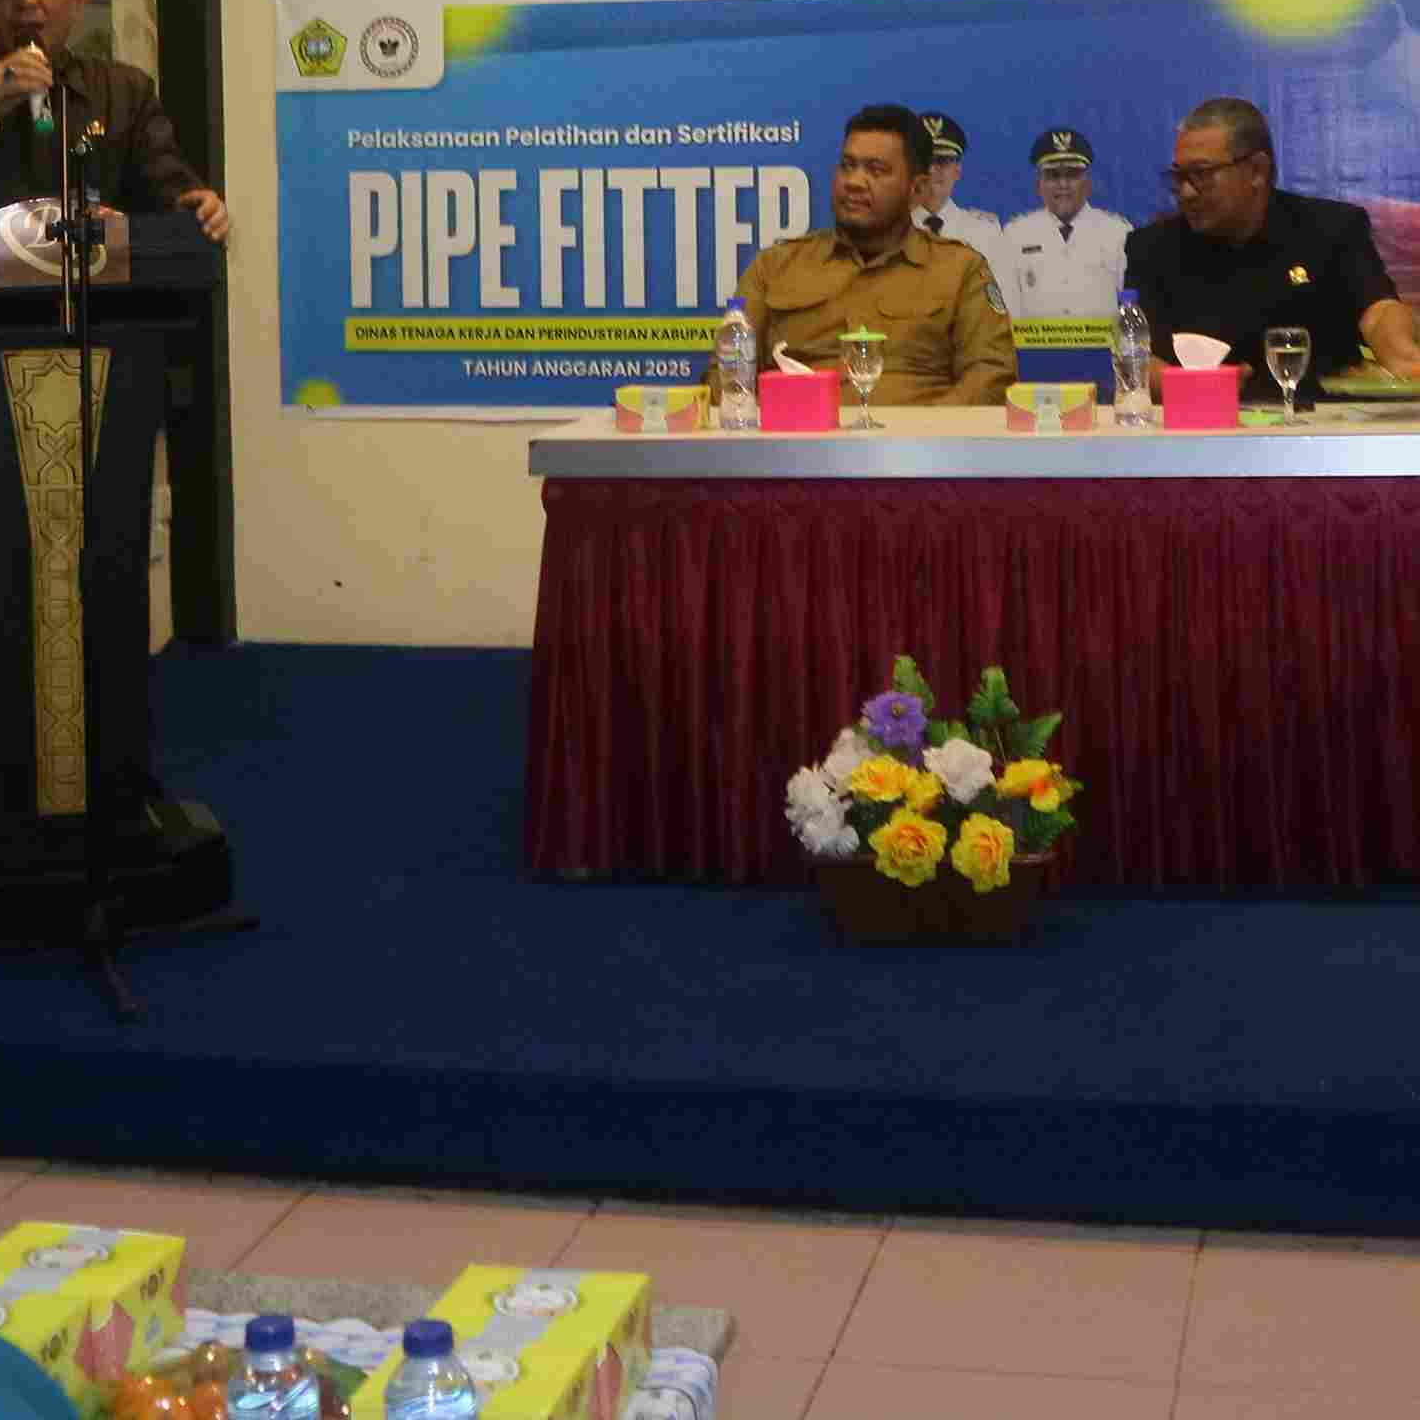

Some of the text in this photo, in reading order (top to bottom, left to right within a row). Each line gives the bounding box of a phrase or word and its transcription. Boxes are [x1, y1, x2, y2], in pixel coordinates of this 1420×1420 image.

[347, 120, 801, 149] Pelaksanaan Pelatihan dan Sertifikasi
[348, 170, 520, 310] PIPE
[355, 326, 716, 341] DINAS TENAGA KERJA DAN PERINDUSTRIAN KABUPAT
[462, 359, 693, 378] TAHUN ANGGARAN 2025
